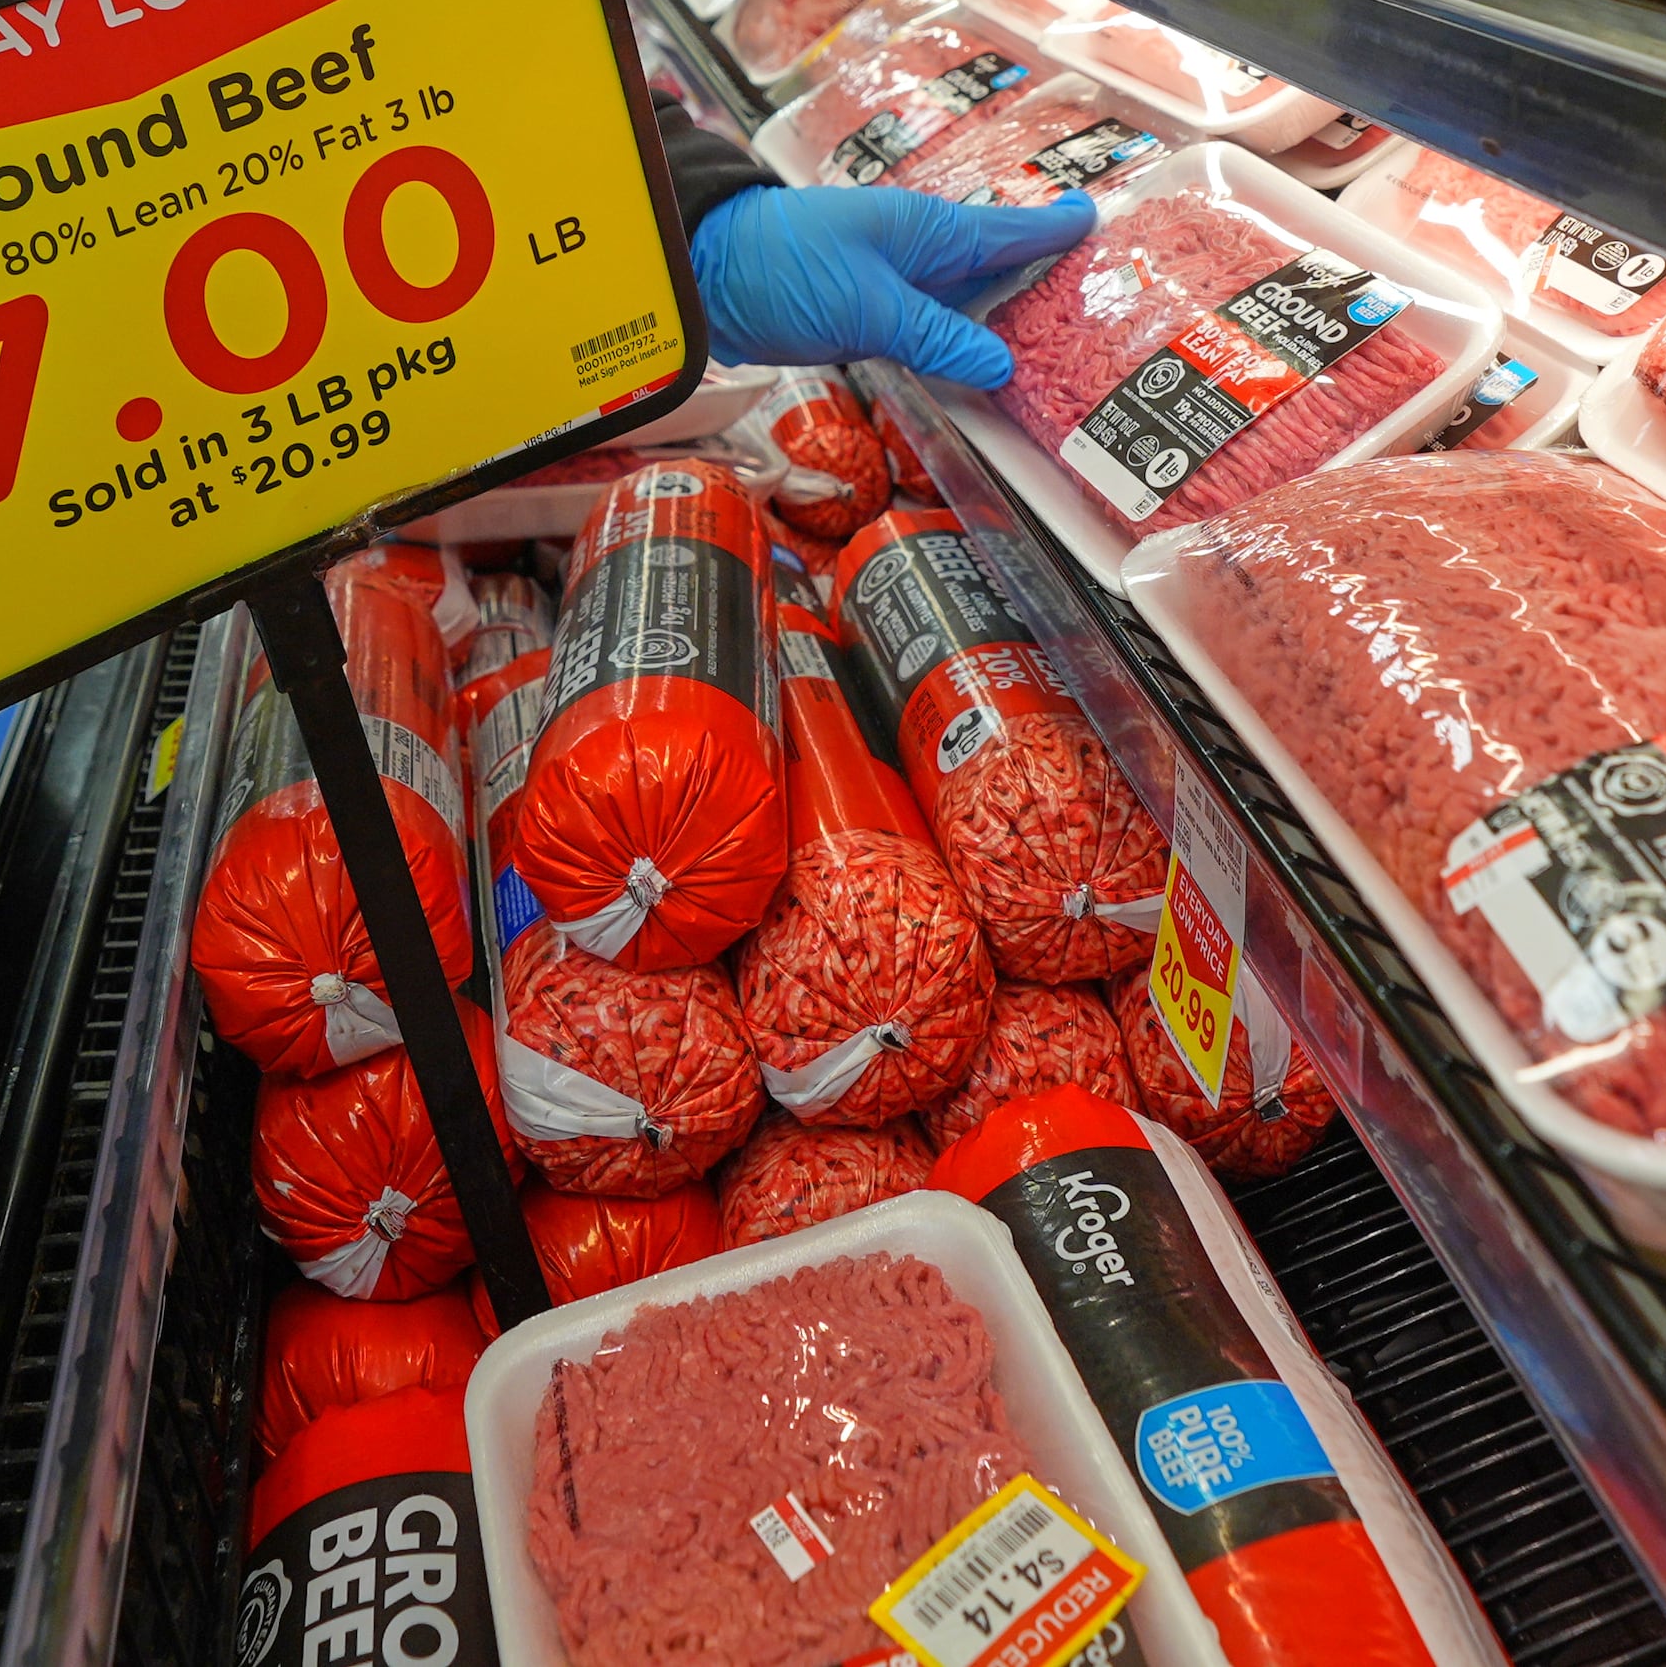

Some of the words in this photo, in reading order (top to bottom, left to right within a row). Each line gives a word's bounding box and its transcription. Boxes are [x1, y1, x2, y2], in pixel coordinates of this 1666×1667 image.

[208, 23, 376, 133] Beef
[0, 216, 97, 276] 80%
[106, 179, 208, 238] Lean
[216, 139, 305, 198] 20%
[313, 111, 379, 160] Fat
[385, 99, 410, 132] 3
[418, 85, 455, 121] lb
[528, 216, 586, 265] LB
[1627, 258, 1649, 277] 1
[1228, 295, 1291, 335] BEEF
[1255, 281, 1349, 345] GROUND
[1356, 304, 1381, 321] BEEF
[1363, 296, 1396, 318] PURE
[576, 333, 656, 376] 0001111097972
[1195, 320, 1233, 349] 80%
[1272, 331, 1302, 356] MOLIDA
[1307, 354, 1325, 371] RES
[1293, 334, 1321, 356] CARNE
[578, 372, 599, 389] Meat
[600, 363, 619, 378] Sign
[619, 354, 639, 370] Post
[639, 344, 662, 362] Insert
[663, 337, 678, 351] 2up
[1179, 333, 1225, 365] LEAN
[1220, 360, 1254, 386] FAT
[632, 386, 651, 401] DAL
[1191, 385, 1205, 398] NO
[1203, 392, 1244, 428] ADDITIVES
[48, 449, 167, 529] Sold
[179, 431, 229, 471] in
[241, 404, 273, 444] 3
[287, 373, 353, 427] LB
[367, 336, 457, 402] pkg
[562, 420, 573, 433] 77
[1173, 398, 1195, 422] 19g
[1193, 411, 1230, 441] PROTEIN
[168, 481, 220, 529] at
[231, 409, 392, 495] $20.99
[1153, 452, 1173, 475] 1
[1165, 461, 1179, 478] lb
[916, 535, 982, 583] BEEF
[660, 606, 692, 626] 19g
[971, 591, 997, 617] CARNE
[558, 624, 604, 707] BEEF
[945, 654, 991, 697] FAT
[975, 647, 1031, 690] 20%
[942, 710, 983, 752] 3
[959, 728, 983, 756] lb
[1177, 872, 1230, 954] EVERYDAY
[1171, 895, 1197, 933] LOW
[1193, 931, 1225, 984] PRICE
[1159, 941, 1216, 1053] 20.99
[1054, 1169, 1135, 1288] Kroger
[1168, 1404, 1233, 1490] PURE
[1205, 1401, 1256, 1469] 100%
[1146, 1427, 1197, 1490] BEEF
[301, 1507, 378, 1667] BEE
